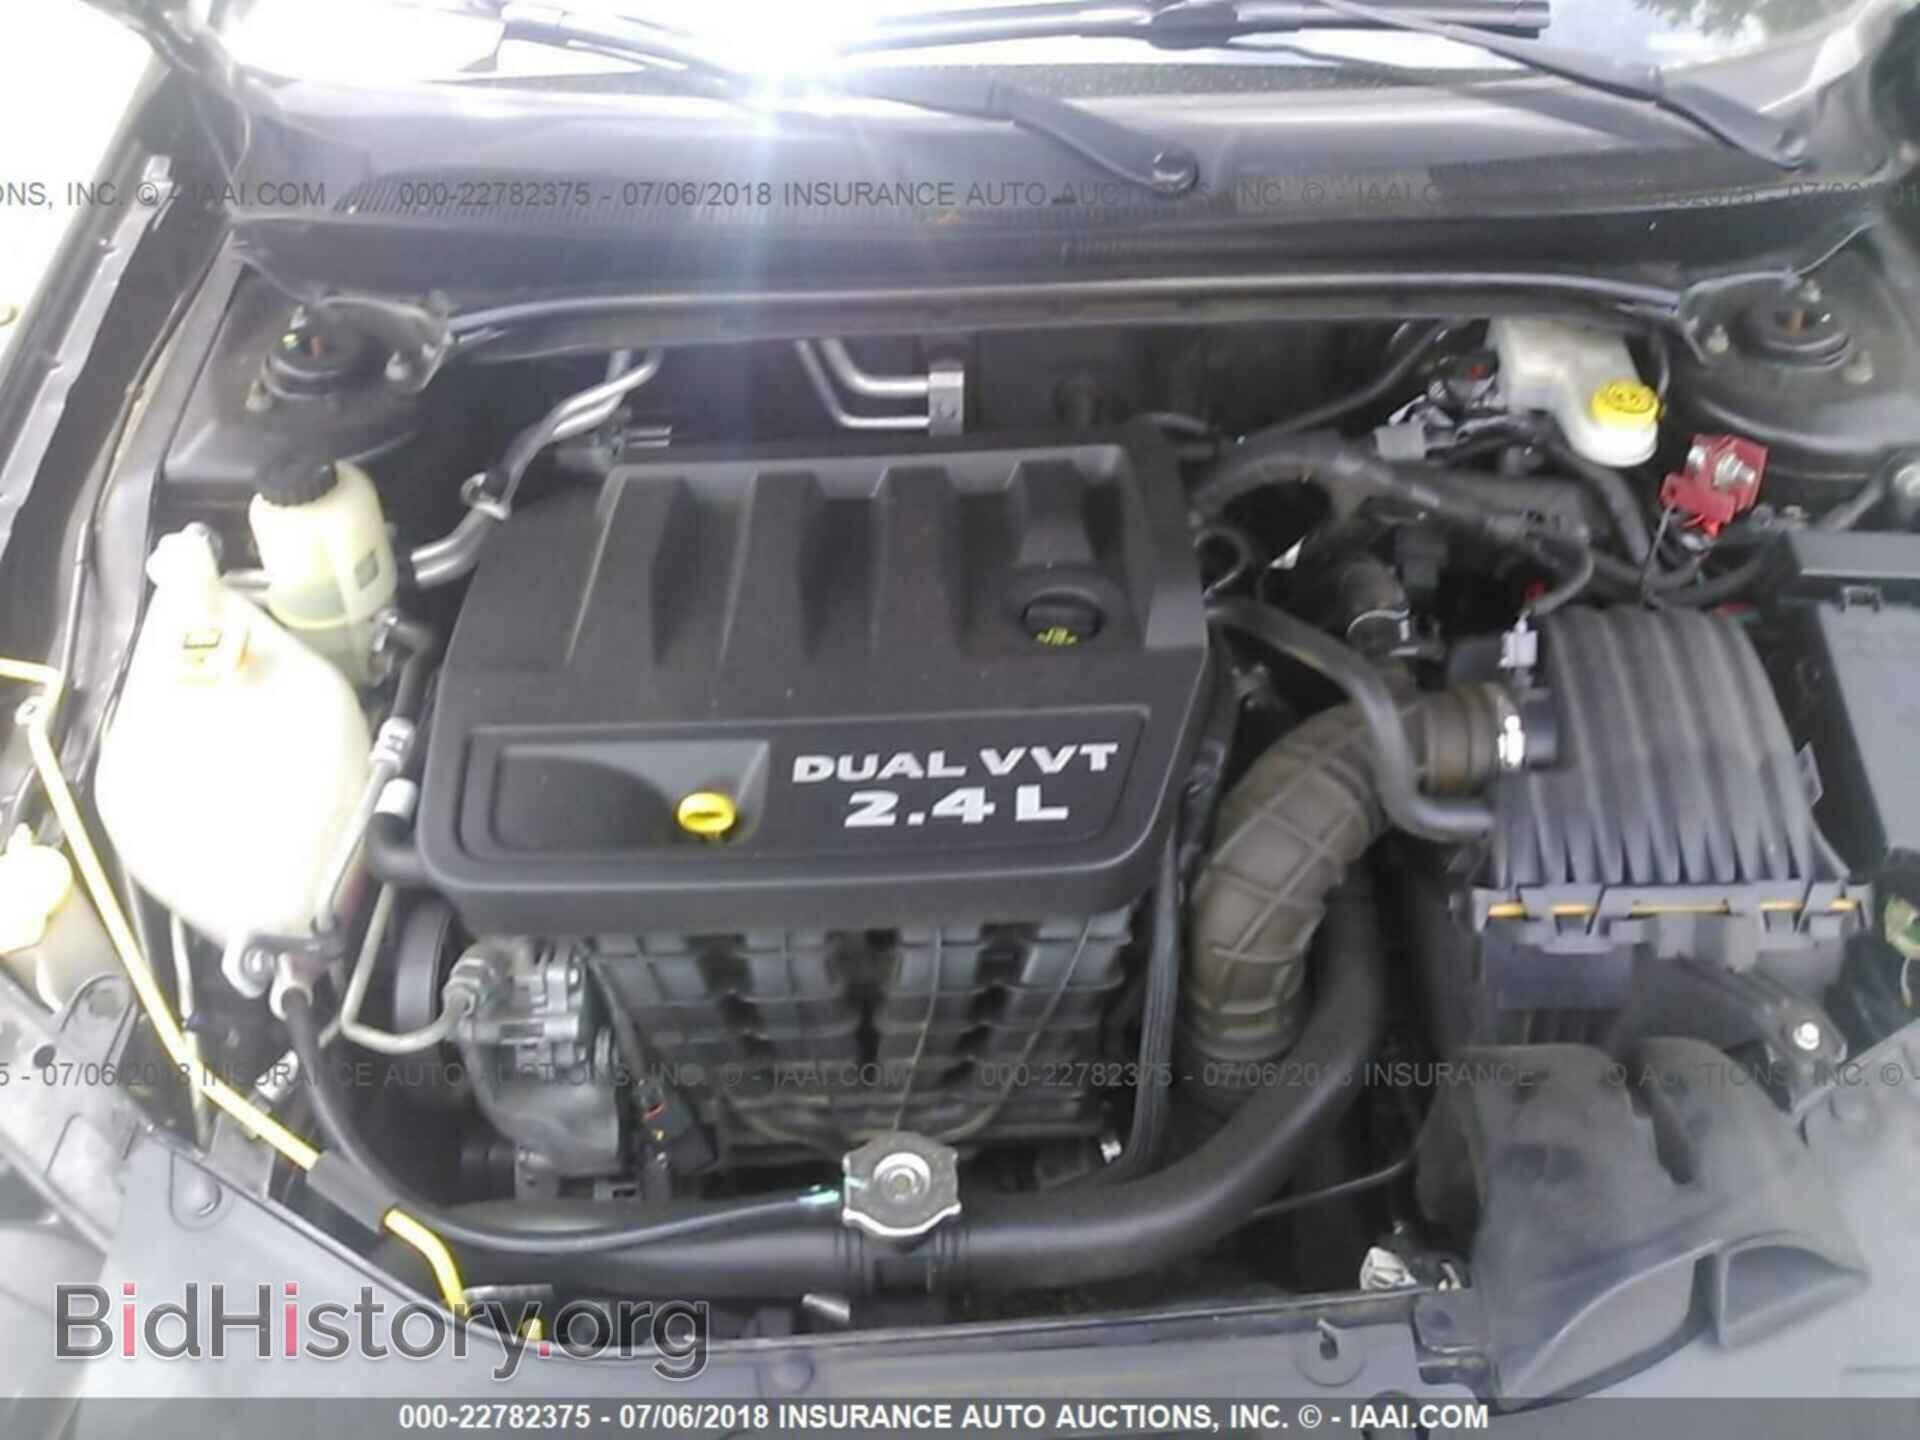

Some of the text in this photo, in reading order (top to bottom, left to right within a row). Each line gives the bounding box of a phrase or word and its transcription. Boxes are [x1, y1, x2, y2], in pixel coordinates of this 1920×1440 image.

[792, 743, 1118, 783] DUAL VVT
[844, 784, 1069, 828] 2.4 L
